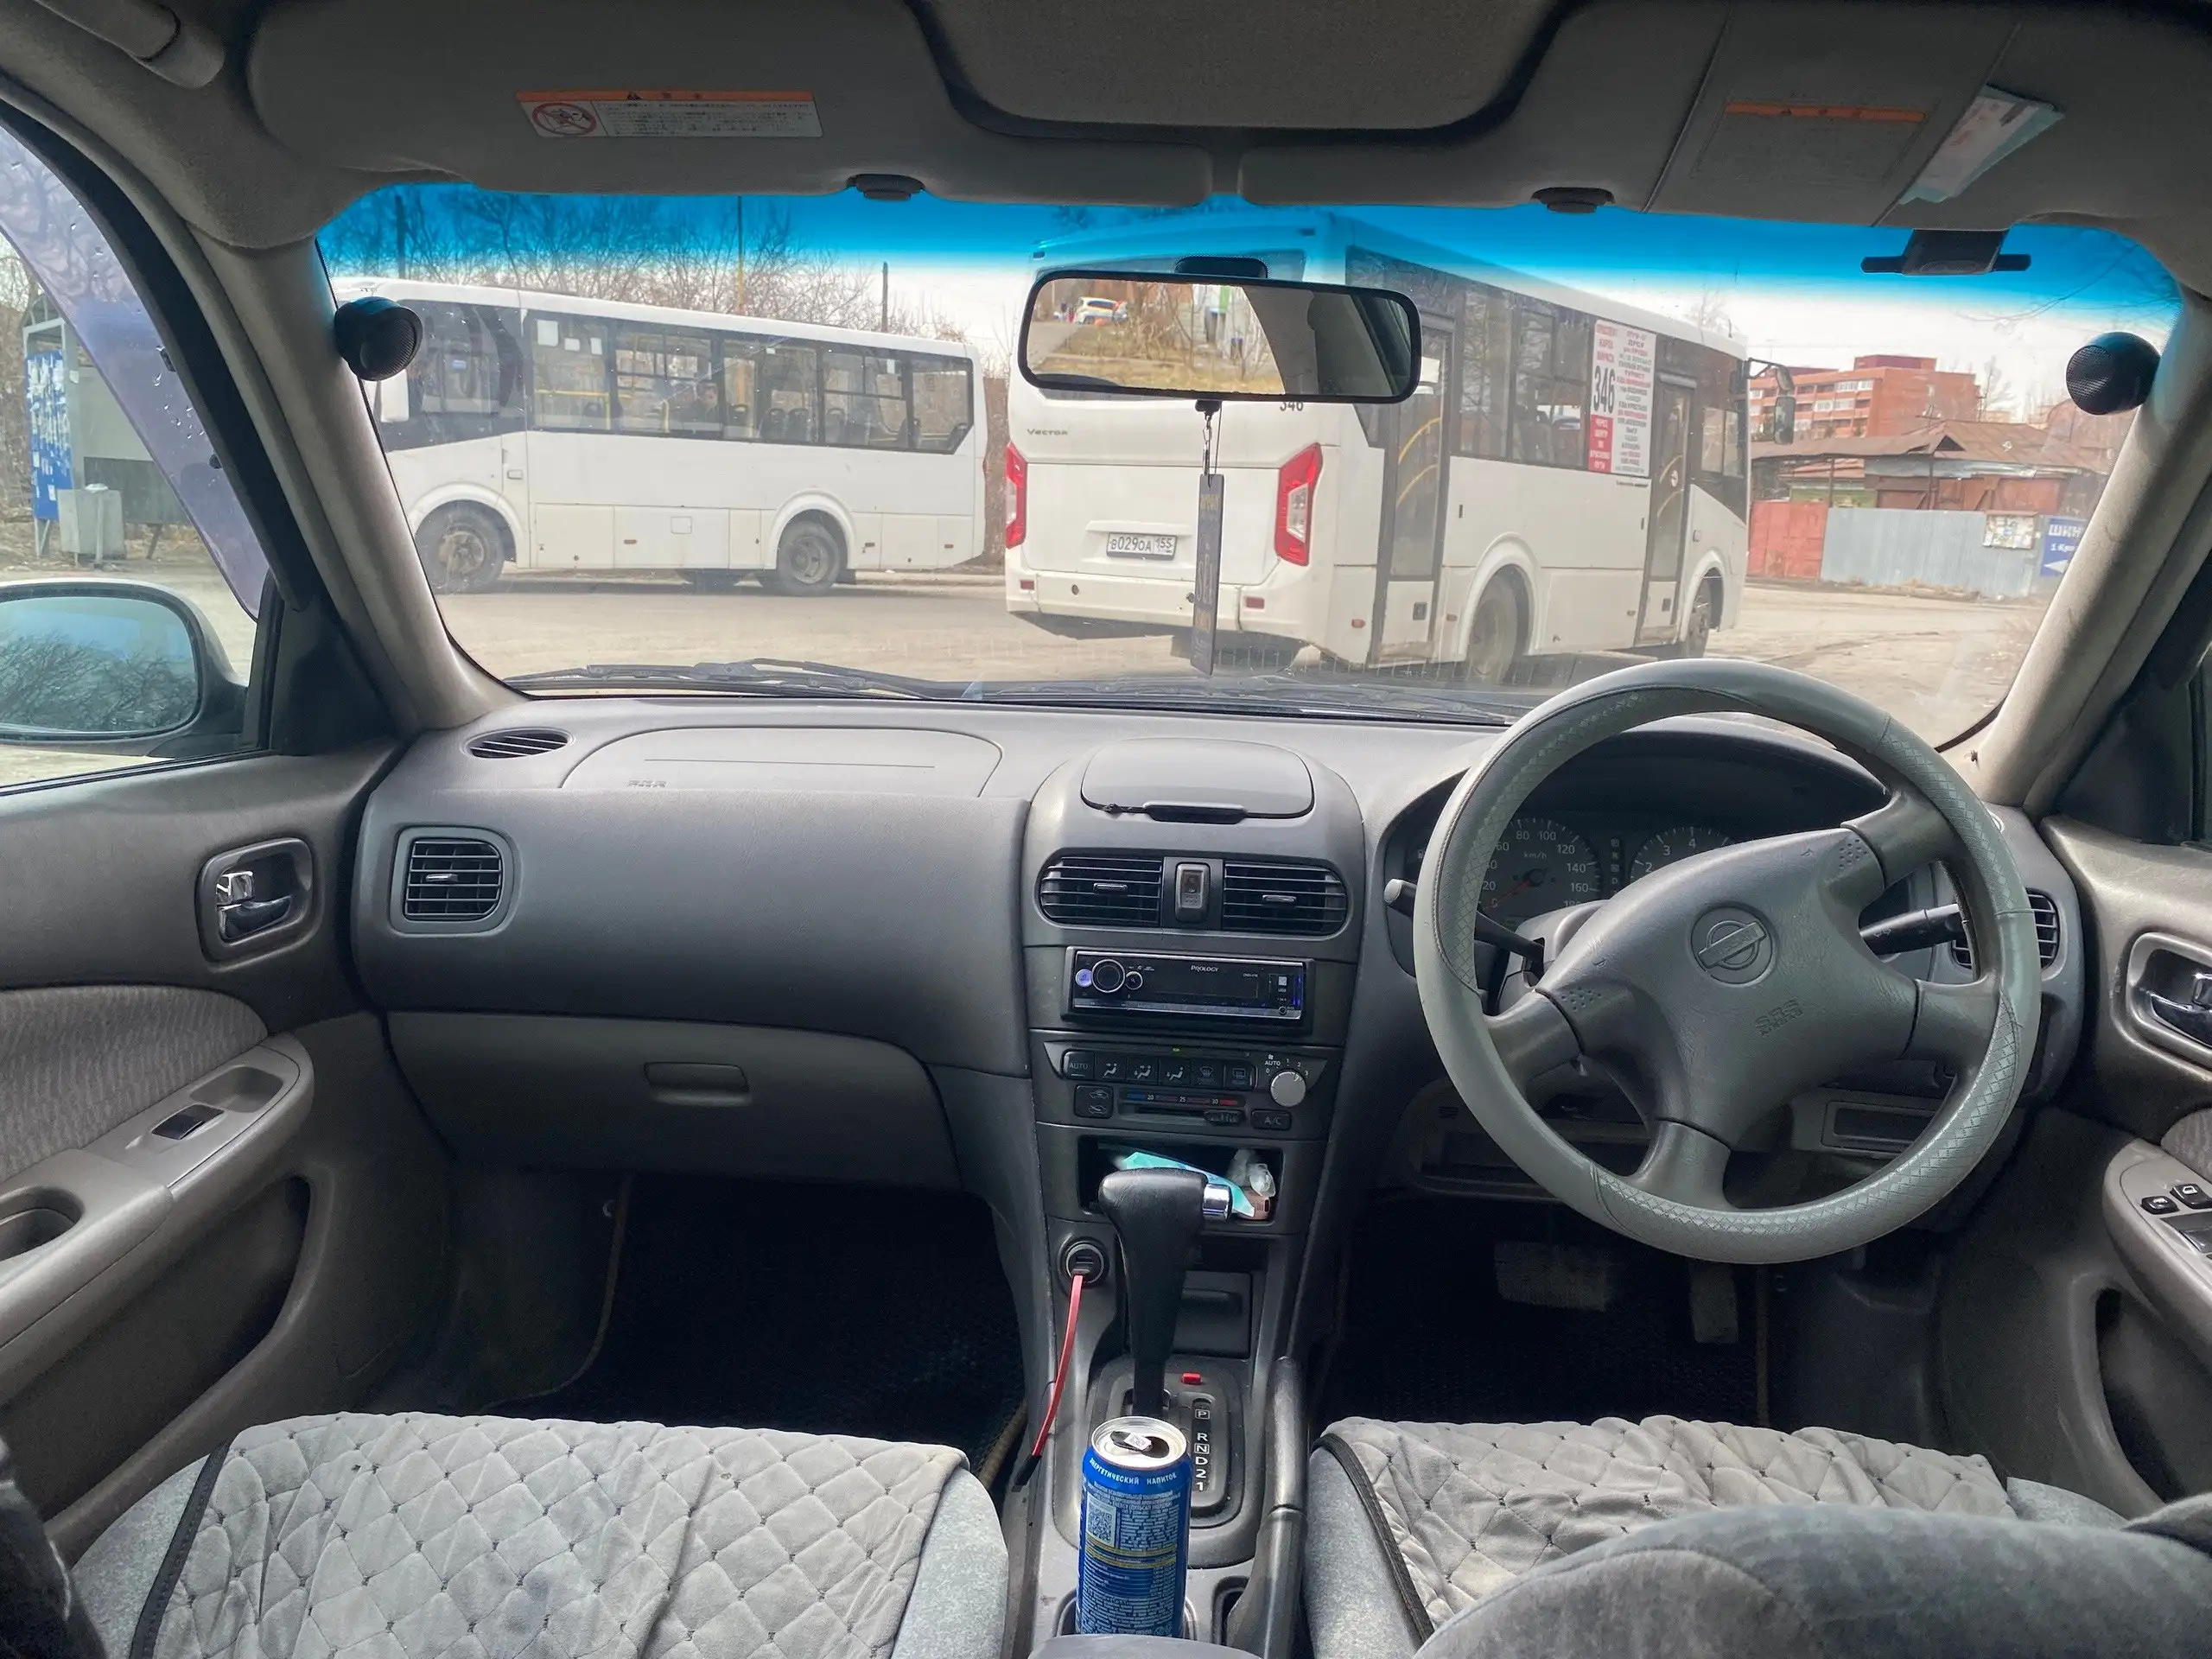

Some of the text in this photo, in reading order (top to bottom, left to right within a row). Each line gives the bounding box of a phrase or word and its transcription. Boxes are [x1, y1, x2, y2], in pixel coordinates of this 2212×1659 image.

[1593, 365, 1616, 414] 346
[1155, 537, 1173, 549] 155
[1516, 830, 1530, 840] 80
[1538, 830, 1556, 841] 100
[1688, 837, 1696, 849] 4
[1556, 844, 1575, 855] 120
[1662, 844, 1671, 855] 3
[1567, 862, 1586, 873] 140
[1645, 861, 1653, 873] 2
[1483, 880, 1497, 891] 20
[1570, 882, 1589, 893] 160
[1264, 1116, 1281, 1125] A/C
[1197, 1433, 1208, 1441] R
[1195, 1456, 1208, 1465] D
[1089, 1457, 1178, 1485] ЭНЕРГЕТИЧЕСКИЙ НАПИТОК
[1195, 1468, 1207, 1478] 2
[1196, 1481, 1204, 1491] 1
